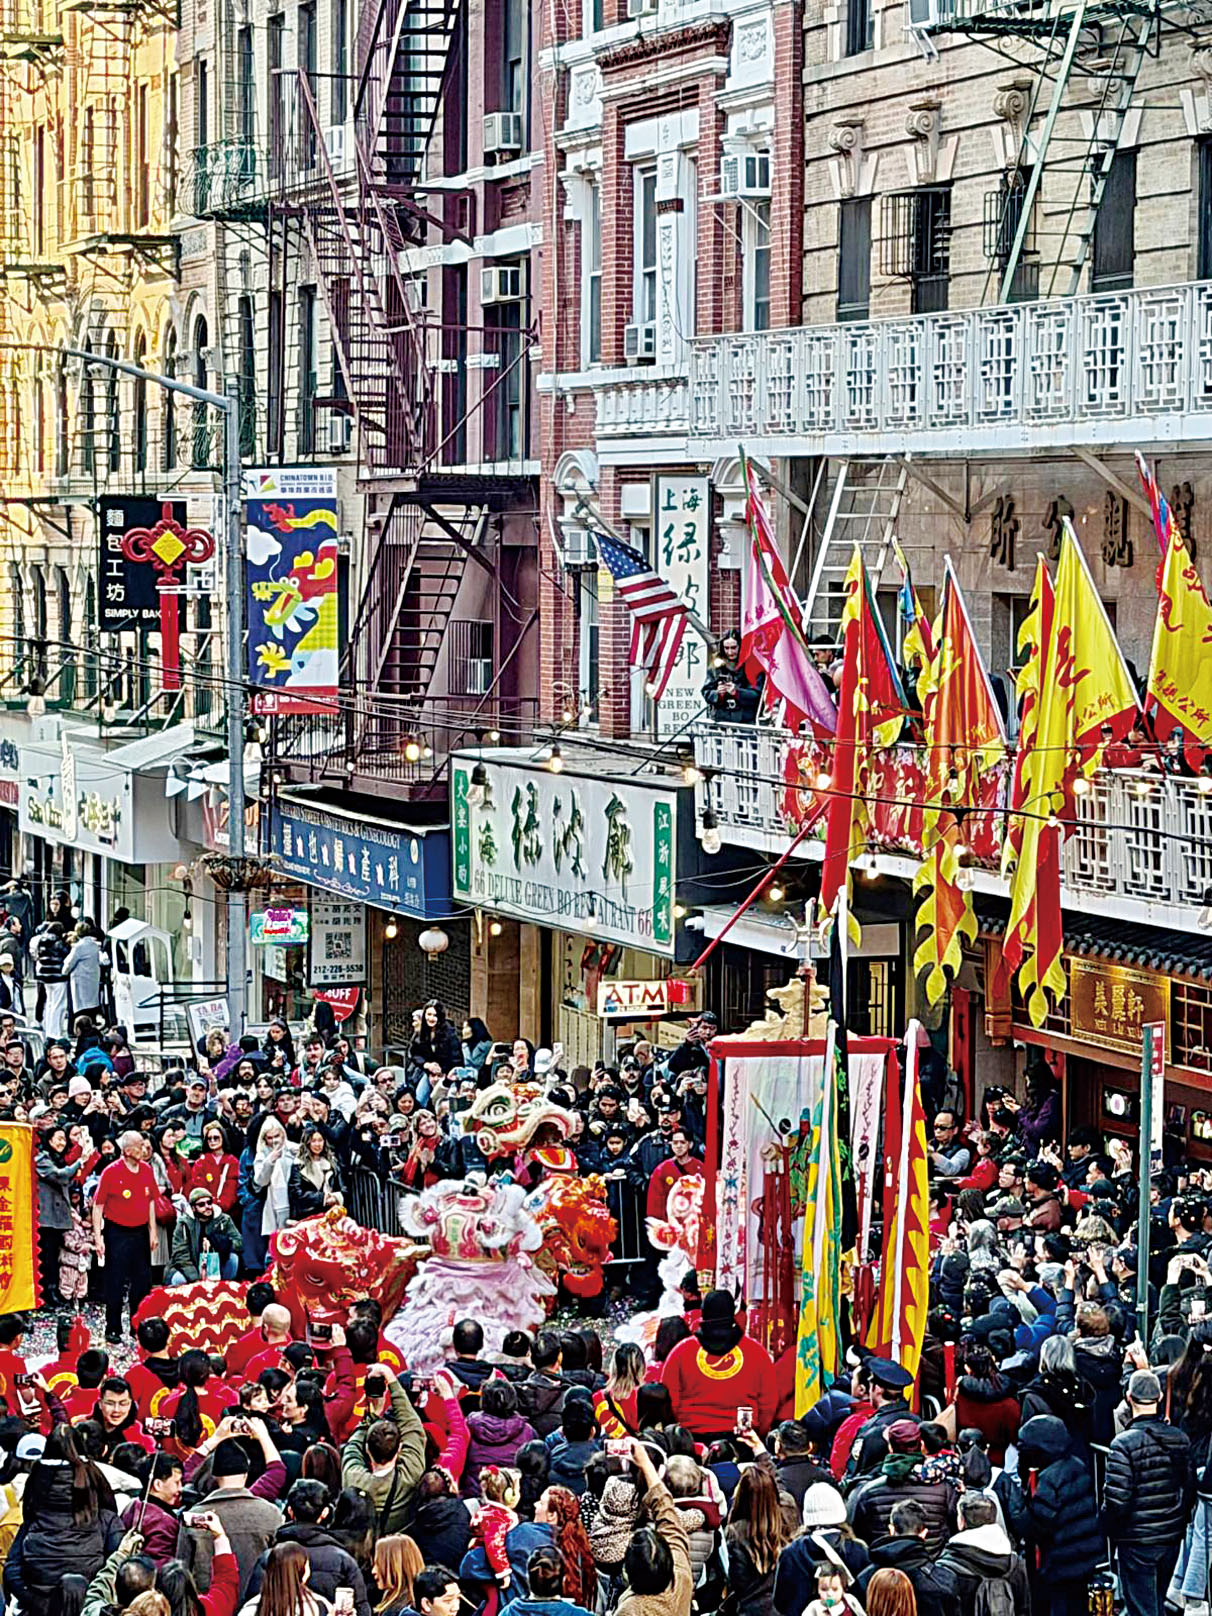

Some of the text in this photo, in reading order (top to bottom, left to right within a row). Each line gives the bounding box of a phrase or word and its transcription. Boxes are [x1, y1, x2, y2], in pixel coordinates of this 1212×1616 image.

[661, 487, 703, 512] 上海
[104, 608, 139, 618] SIMPLY
[665, 688, 695, 697] NEW
[658, 700, 702, 710] GREEN
[672, 712, 690, 721] BO
[474, 868, 651, 937] 66 DELUXE GREEN BO RESAURANT 66
[606, 983, 665, 1005] ATM
